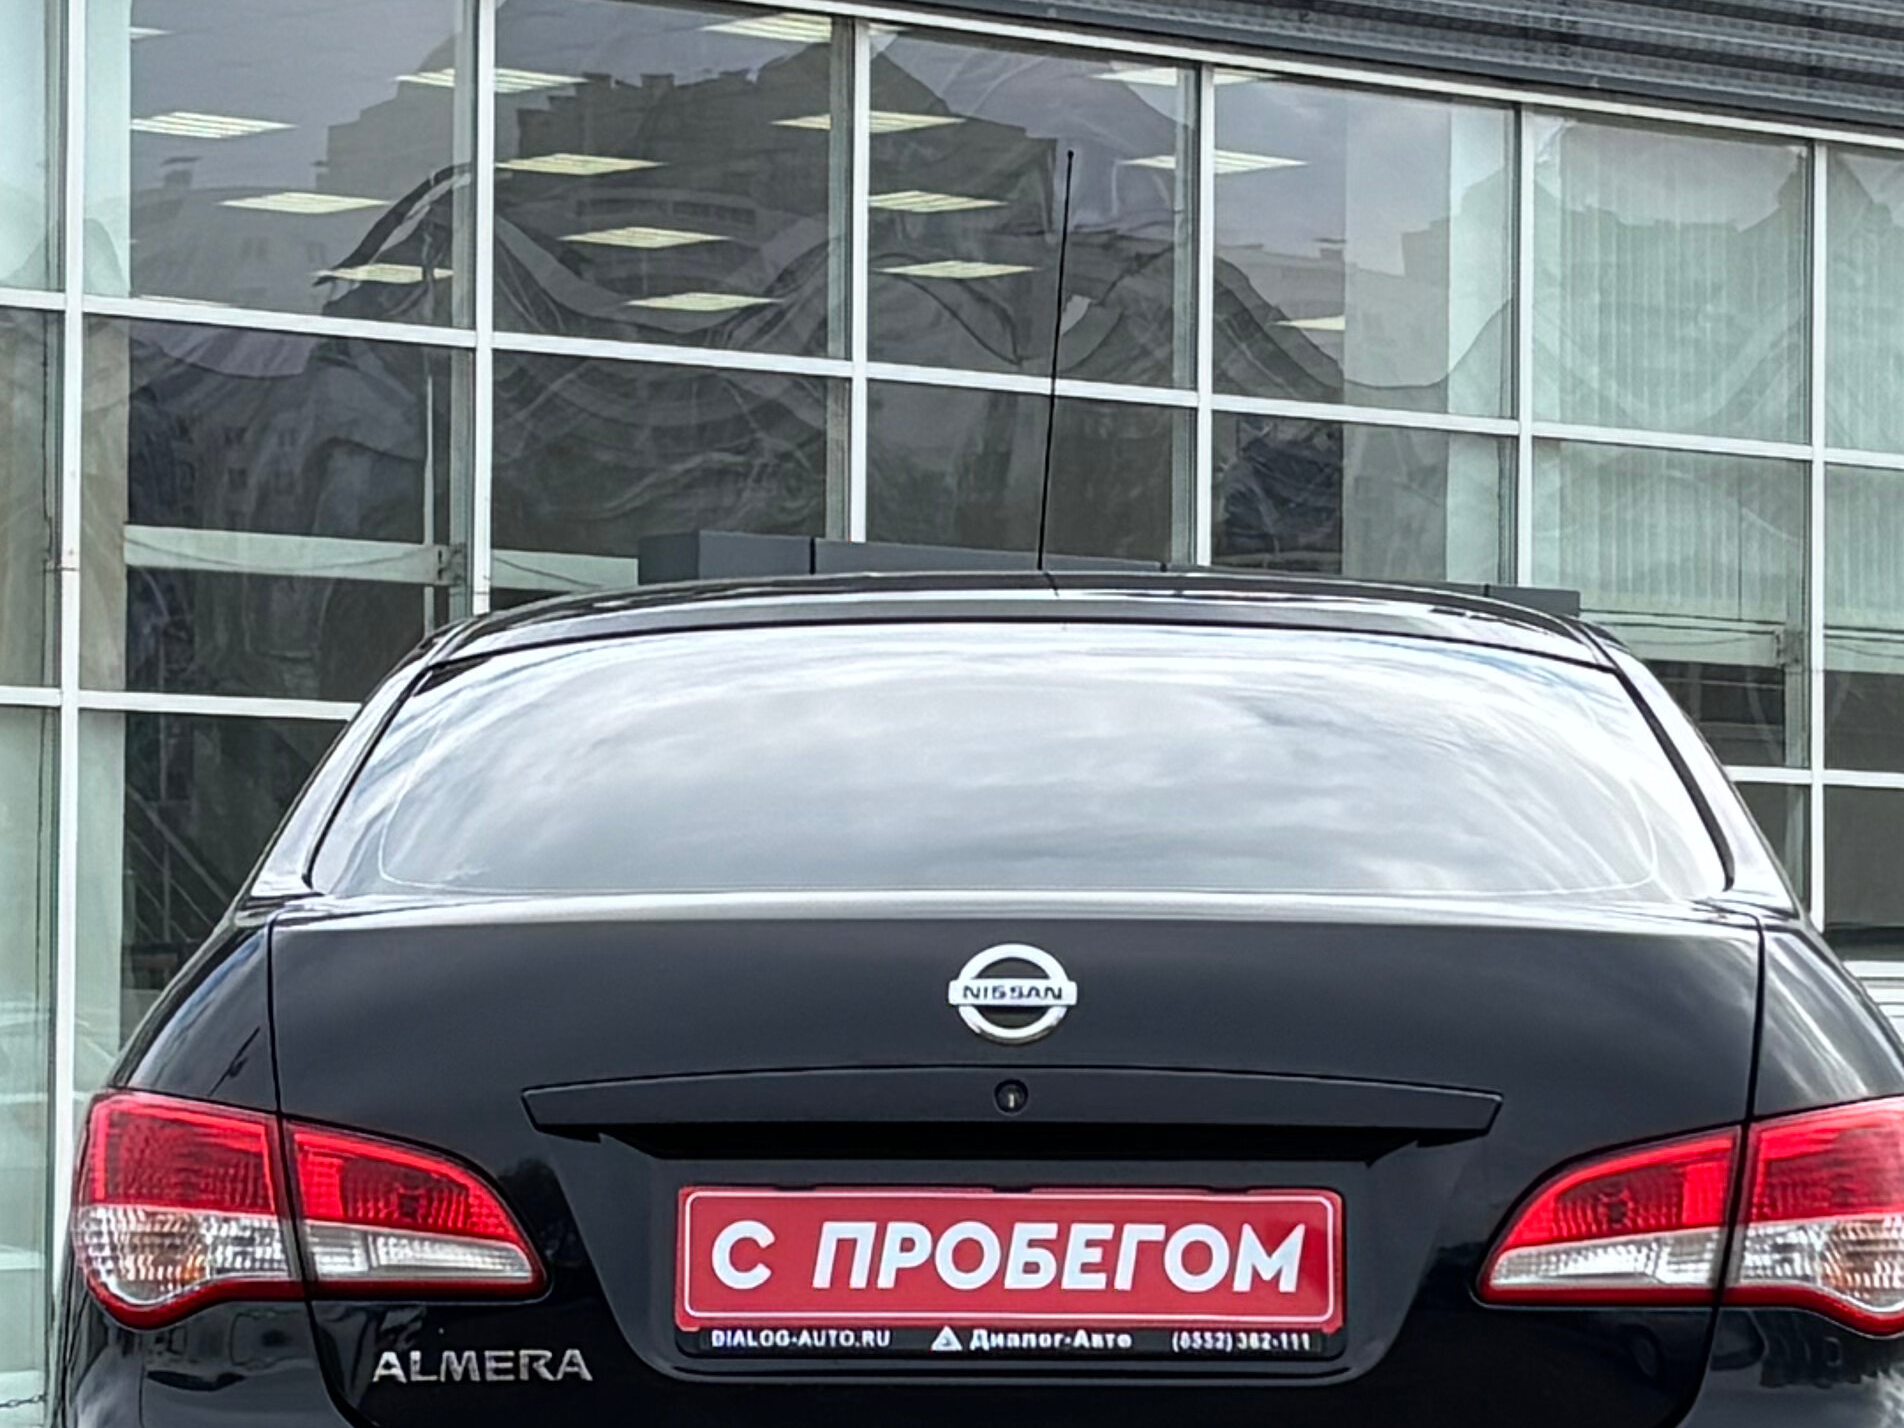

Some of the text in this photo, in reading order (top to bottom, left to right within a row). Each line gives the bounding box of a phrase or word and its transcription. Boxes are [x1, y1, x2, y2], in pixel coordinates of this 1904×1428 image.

[962, 984, 1063, 1000] NISSAN
[711, 1219, 1306, 1292] С ПРОБЕГОМ
[710, 1329, 891, 1348] DIALOG-AUTO.RU
[968, 1328, 1133, 1351] Диалог-Авто
[372, 1349, 594, 1383] ALMERA
